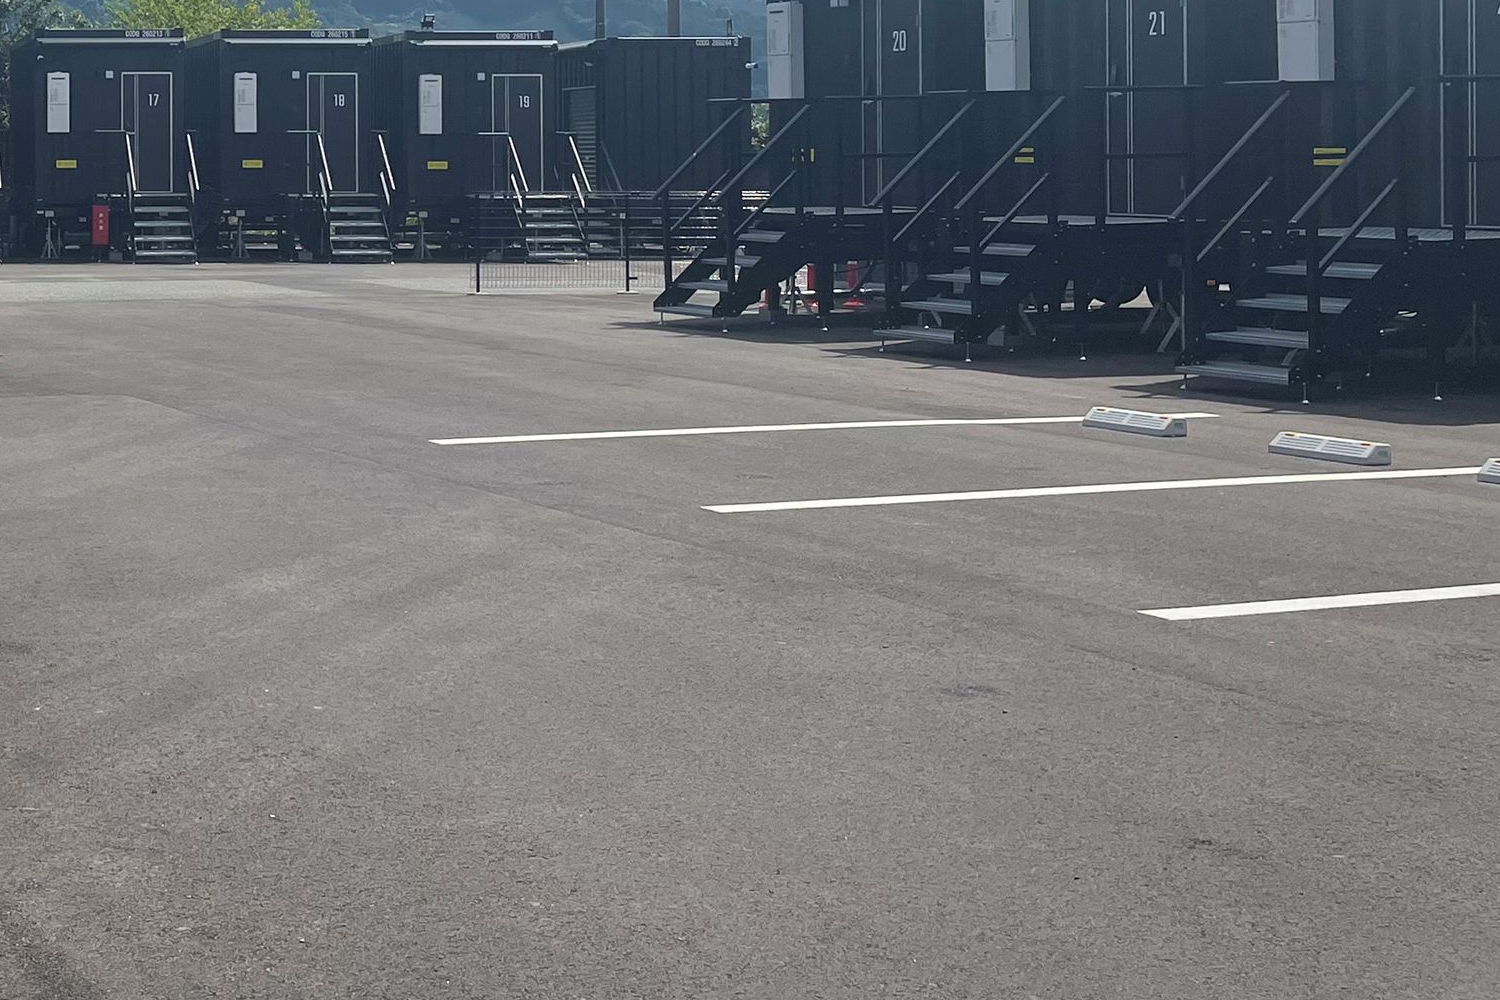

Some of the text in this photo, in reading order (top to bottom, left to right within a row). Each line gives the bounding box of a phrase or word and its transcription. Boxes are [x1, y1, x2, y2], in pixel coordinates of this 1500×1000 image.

[1149, 11, 1165, 36] 21
[892, 30, 906, 51] 20
[148, 93, 160, 106] 17
[334, 94, 345, 107] 18
[519, 95, 530, 108] 19
